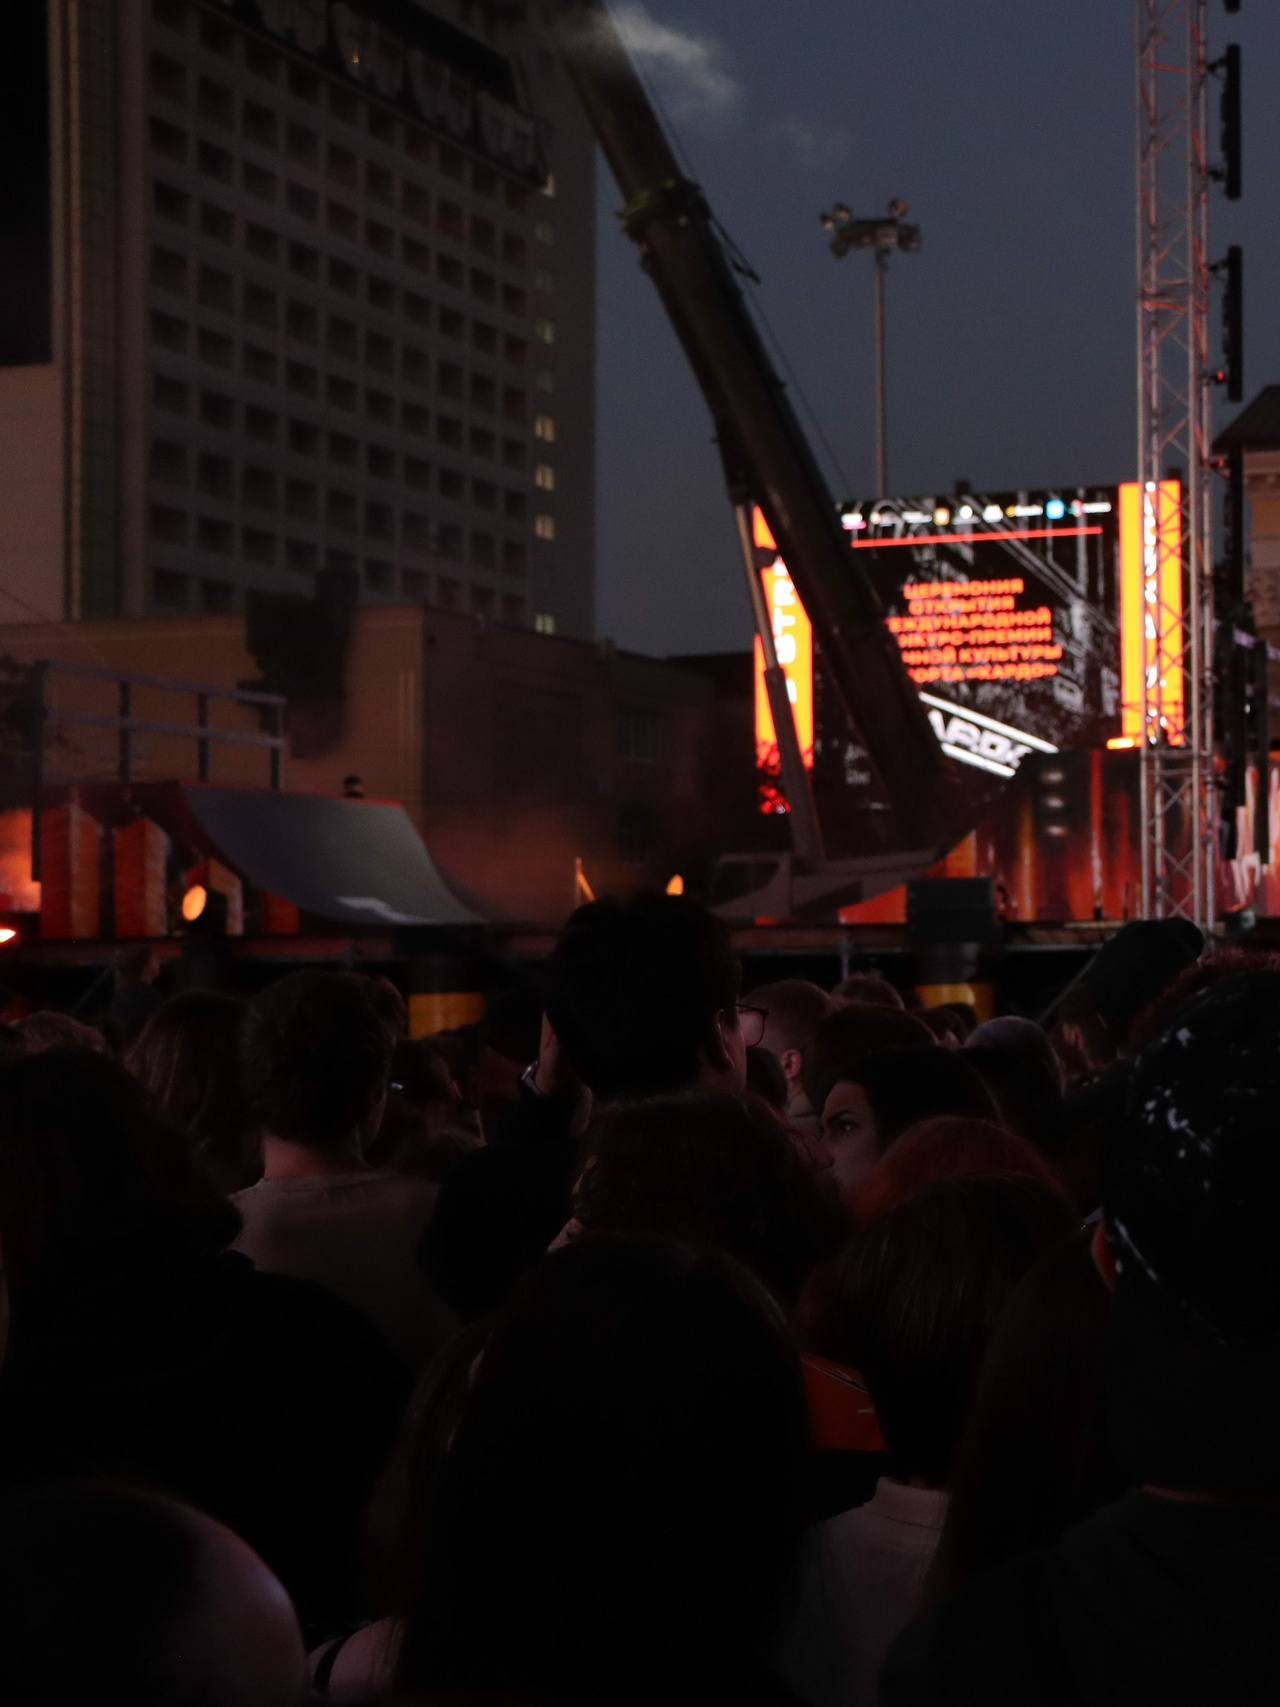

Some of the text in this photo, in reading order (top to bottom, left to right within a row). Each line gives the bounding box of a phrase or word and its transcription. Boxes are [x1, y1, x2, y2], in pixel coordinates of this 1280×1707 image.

[904, 579, 1023, 600] ЦЕРЕМОНИЯ
[909, 596, 1015, 616] ОТКРЫТИЯ
[888, 607, 1052, 633] ЕЖДУНАРОДНОЙ
[958, 645, 1063, 663] КУЛЬТУРЫ
